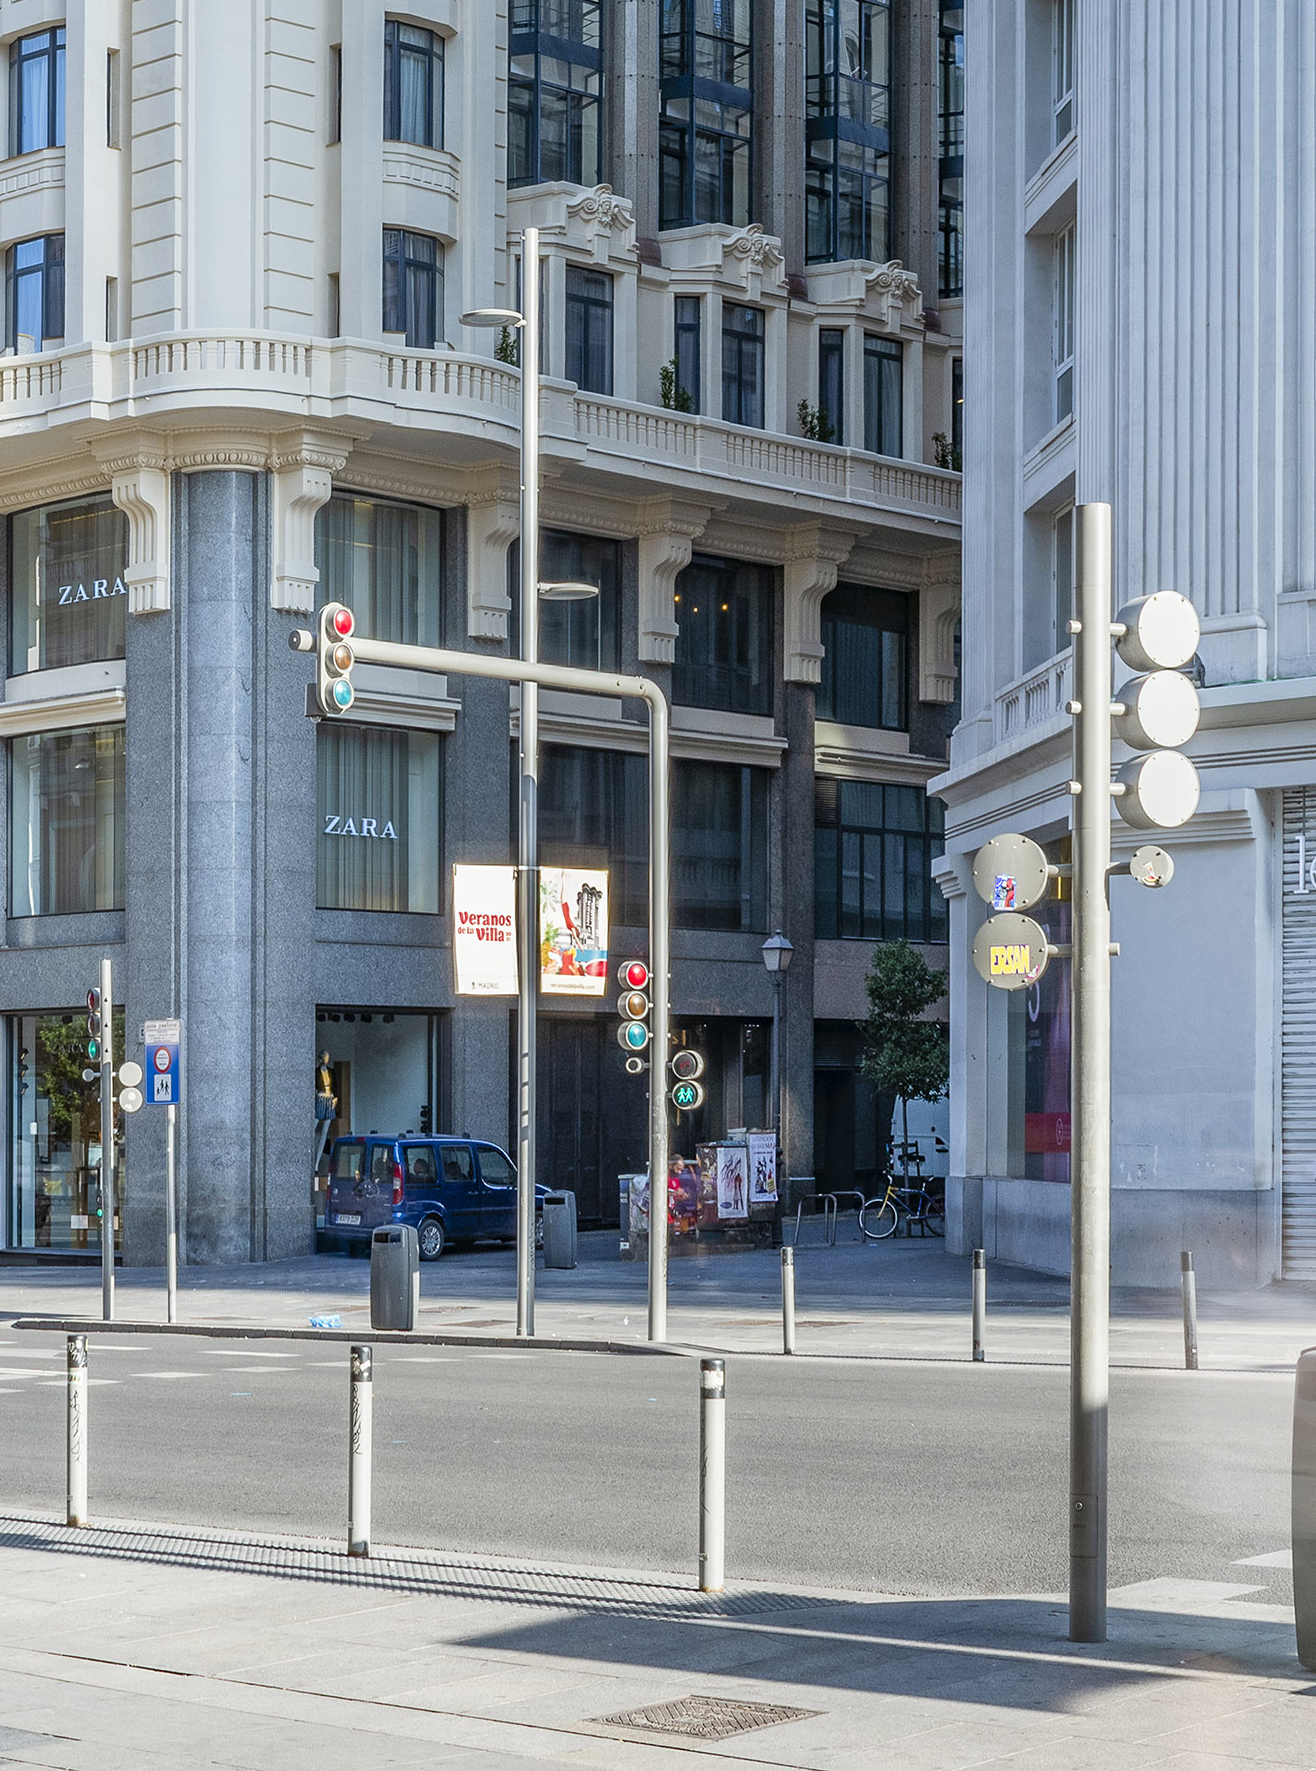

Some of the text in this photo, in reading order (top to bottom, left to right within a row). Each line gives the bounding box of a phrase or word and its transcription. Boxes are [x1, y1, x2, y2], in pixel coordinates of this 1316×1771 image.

[58, 576, 127, 605] ZARA
[324, 815, 399, 839] ZARA
[458, 911, 512, 927] Veranos
[457, 927, 505, 942] de la Villa
